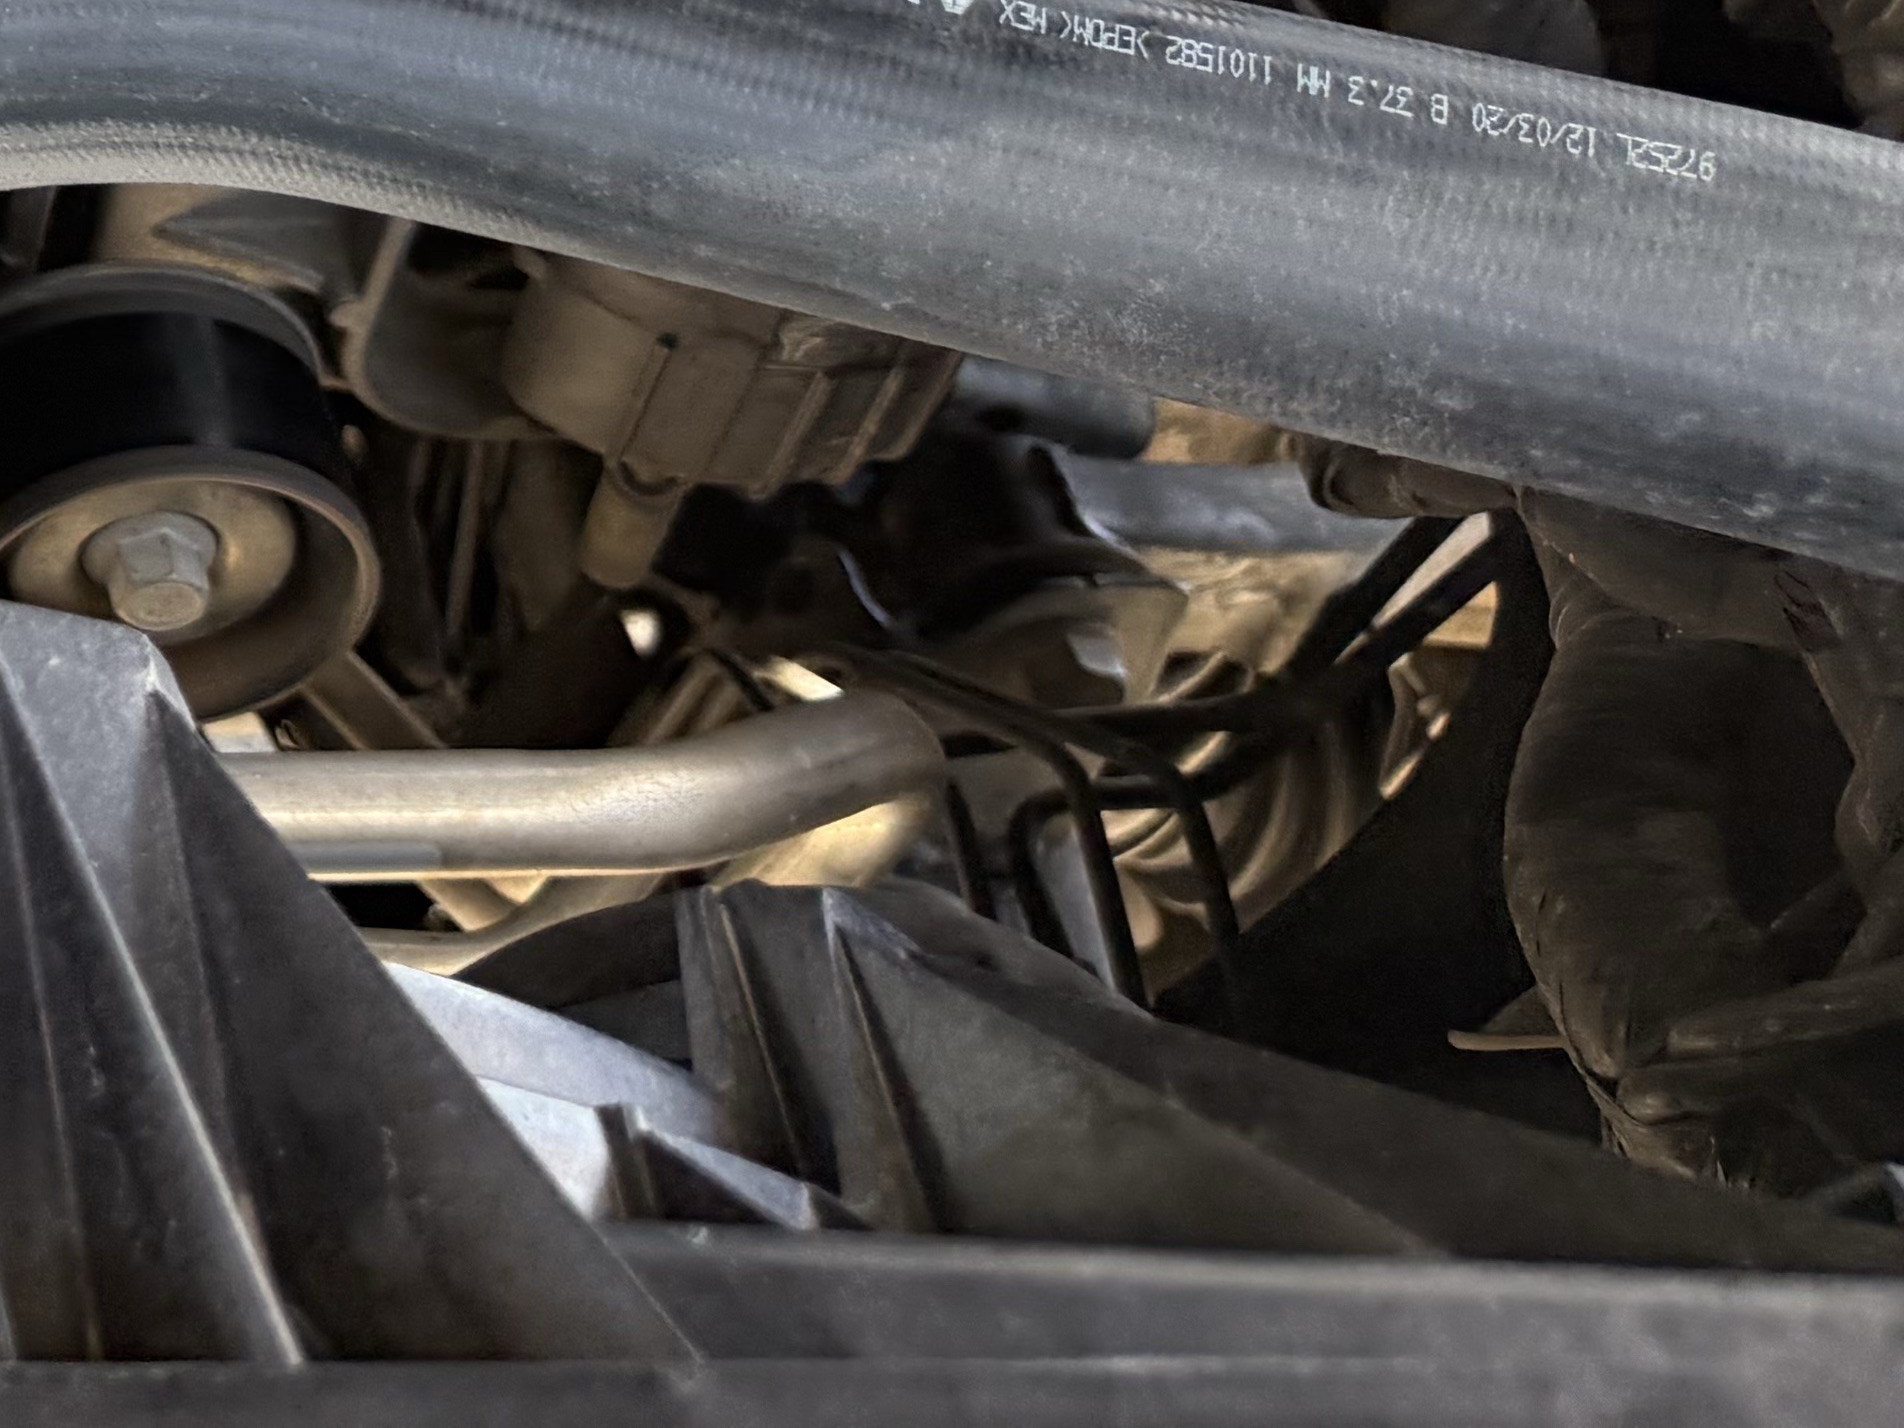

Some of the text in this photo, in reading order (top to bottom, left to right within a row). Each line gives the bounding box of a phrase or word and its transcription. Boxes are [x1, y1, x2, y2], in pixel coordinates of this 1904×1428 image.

[1166, 36, 1272, 85] 1101582
[1297, 62, 1330, 97] MM
[1347, 76, 1413, 117] 37.3
[1431, 94, 1448, 125] B
[1472, 103, 1597, 157] 12/03/20
